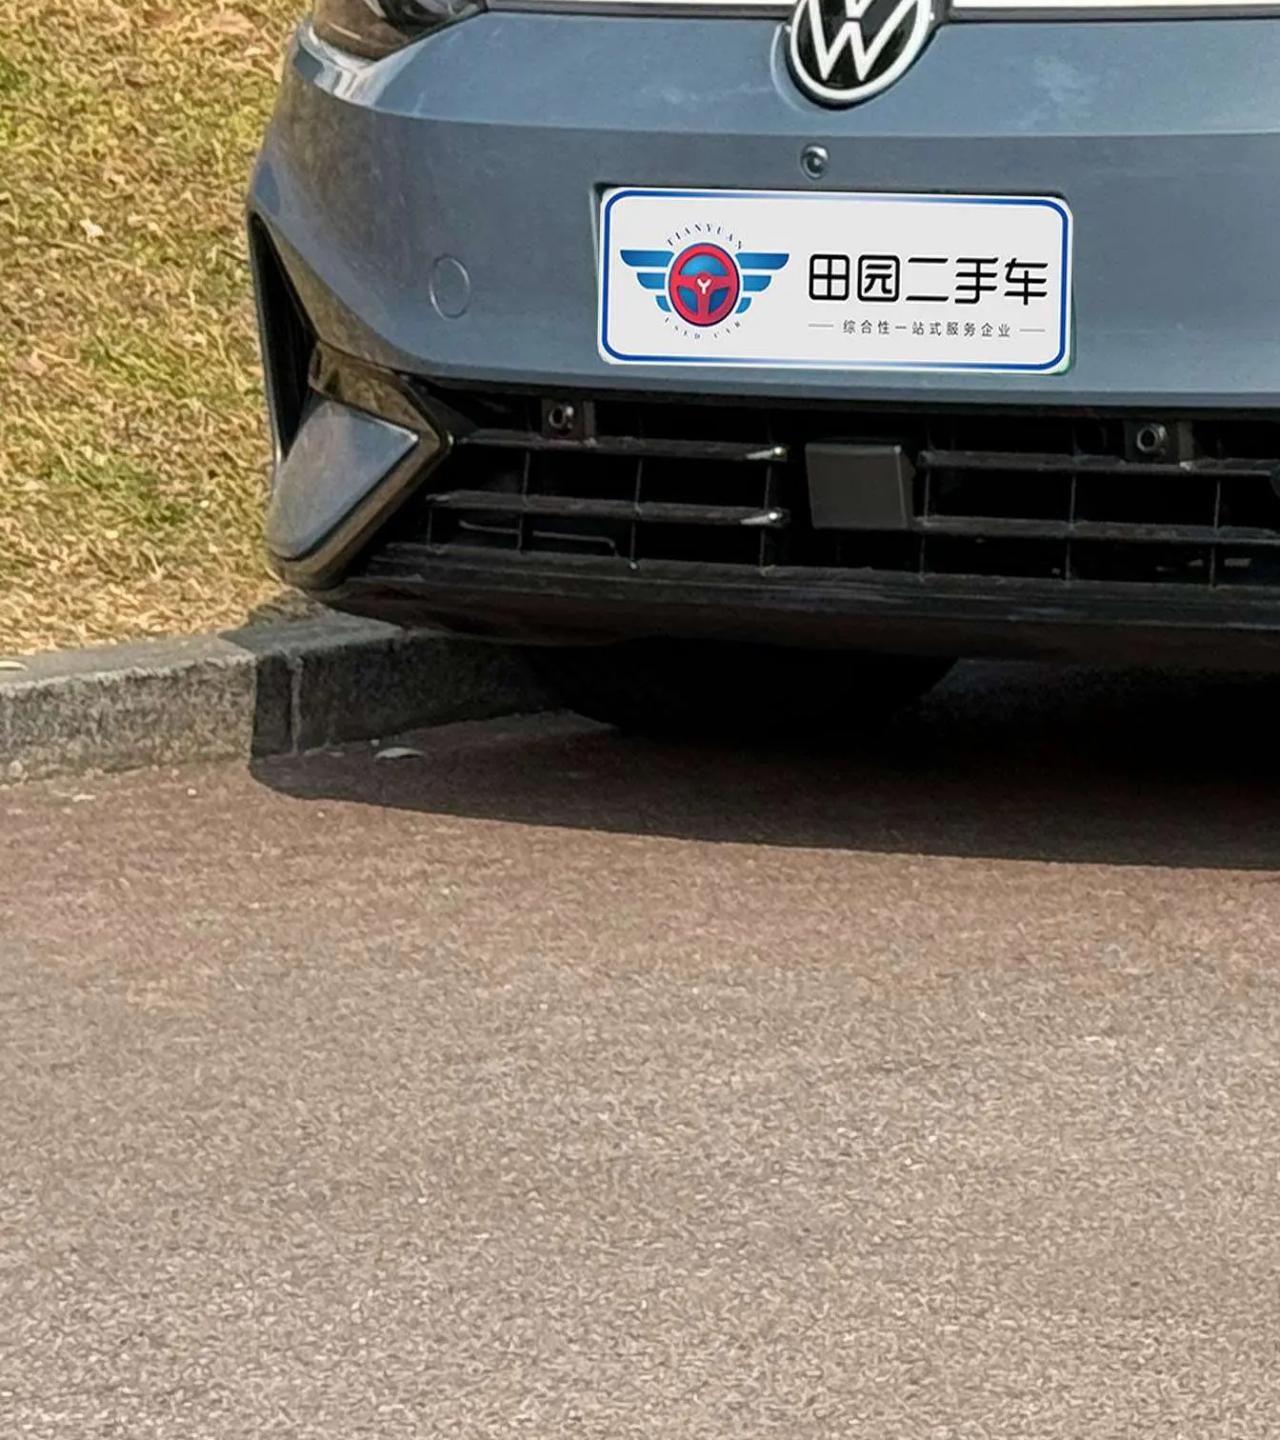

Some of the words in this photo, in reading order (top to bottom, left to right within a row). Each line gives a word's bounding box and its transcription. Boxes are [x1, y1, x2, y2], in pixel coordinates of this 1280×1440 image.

[808, 253, 1049, 306] 田园二手车
[842, 319, 1012, 338] 综合性一站式服务企业
